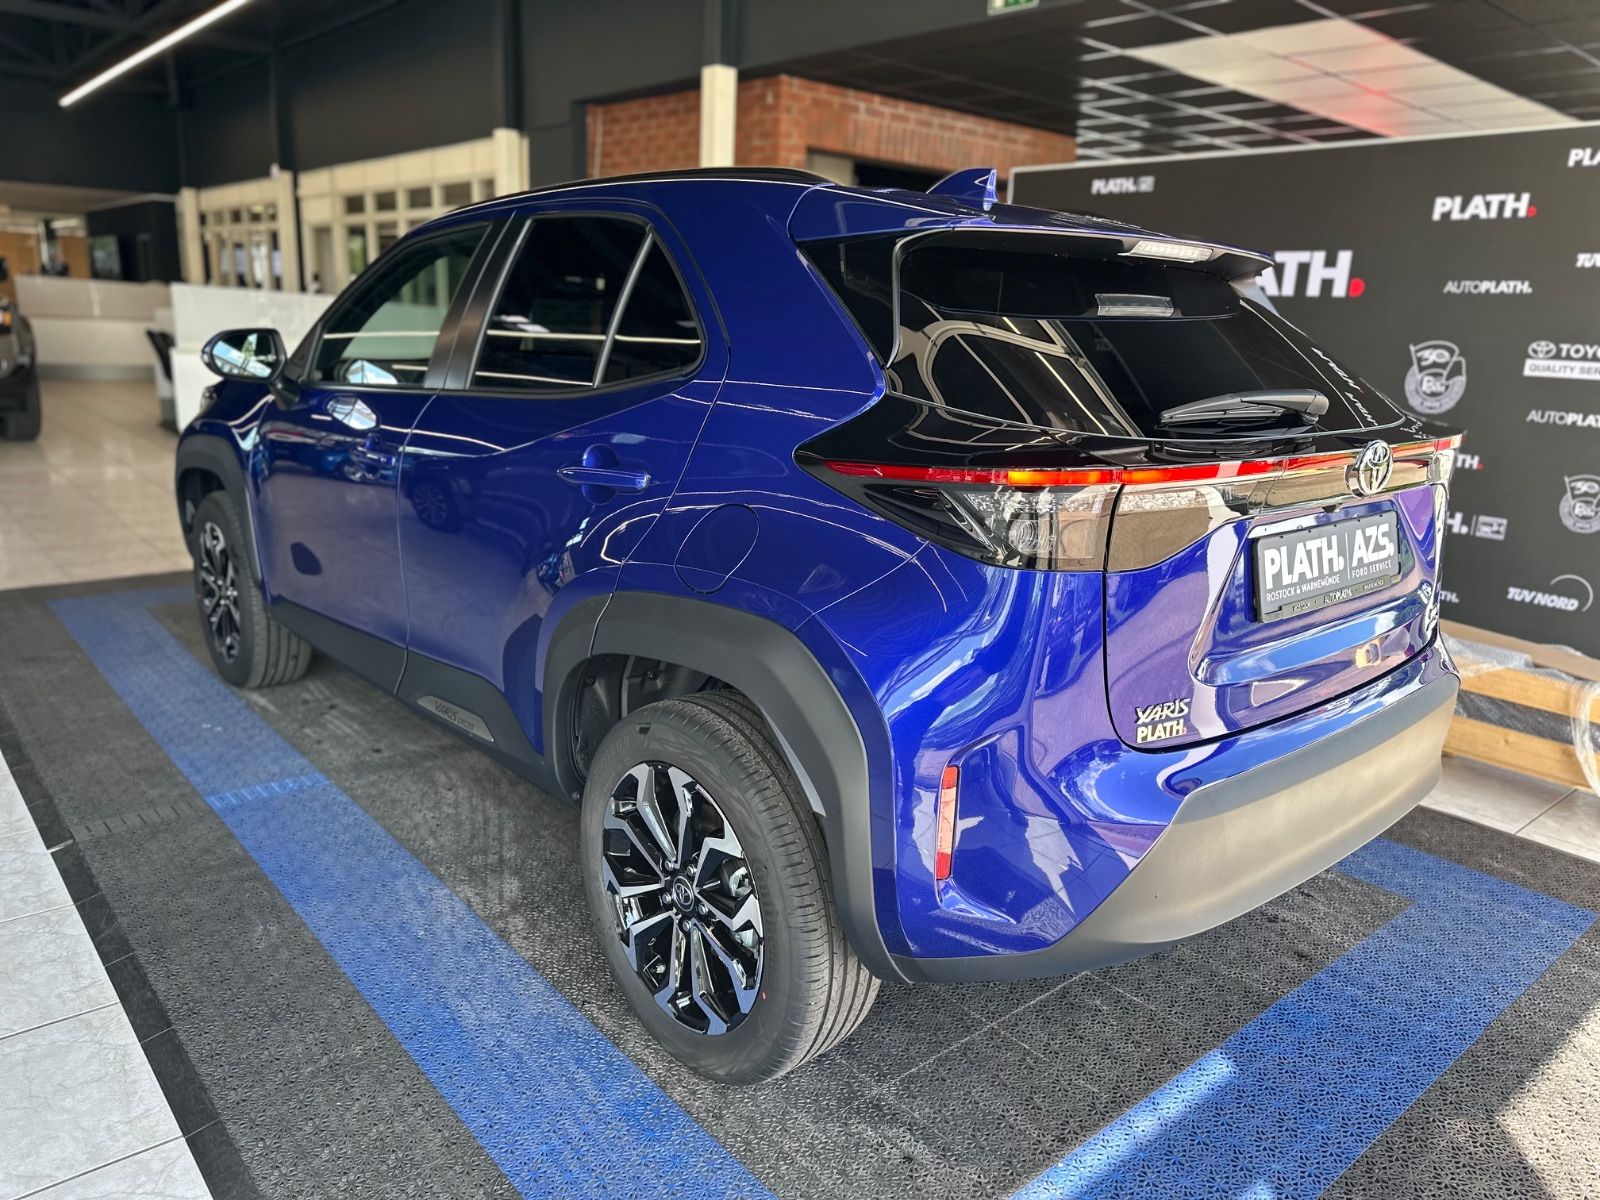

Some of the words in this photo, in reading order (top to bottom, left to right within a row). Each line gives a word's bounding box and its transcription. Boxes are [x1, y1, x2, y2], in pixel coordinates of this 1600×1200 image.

[1431, 192, 1537, 221] PLATH.
[1443, 280, 1533, 294] AUTOPLATH.
[1528, 363, 1576, 375] QUALITY
[1351, 522, 1395, 568] AZS.
[1263, 534, 1345, 590] PLATH.
[1352, 566, 1368, 579] FORD
[1369, 559, 1392, 574] SERVICE
[1266, 587, 1295, 602] ROSTOCK
[1296, 585, 1301, 595] &
[1301, 574, 1341, 591] WARNEMÜNDE
[1533, 591, 1579, 611] NORD
[434, 700, 458, 721] YARIS
[1136, 698, 1191, 724] YARIS
[1136, 719, 1187, 743] PLATH.
